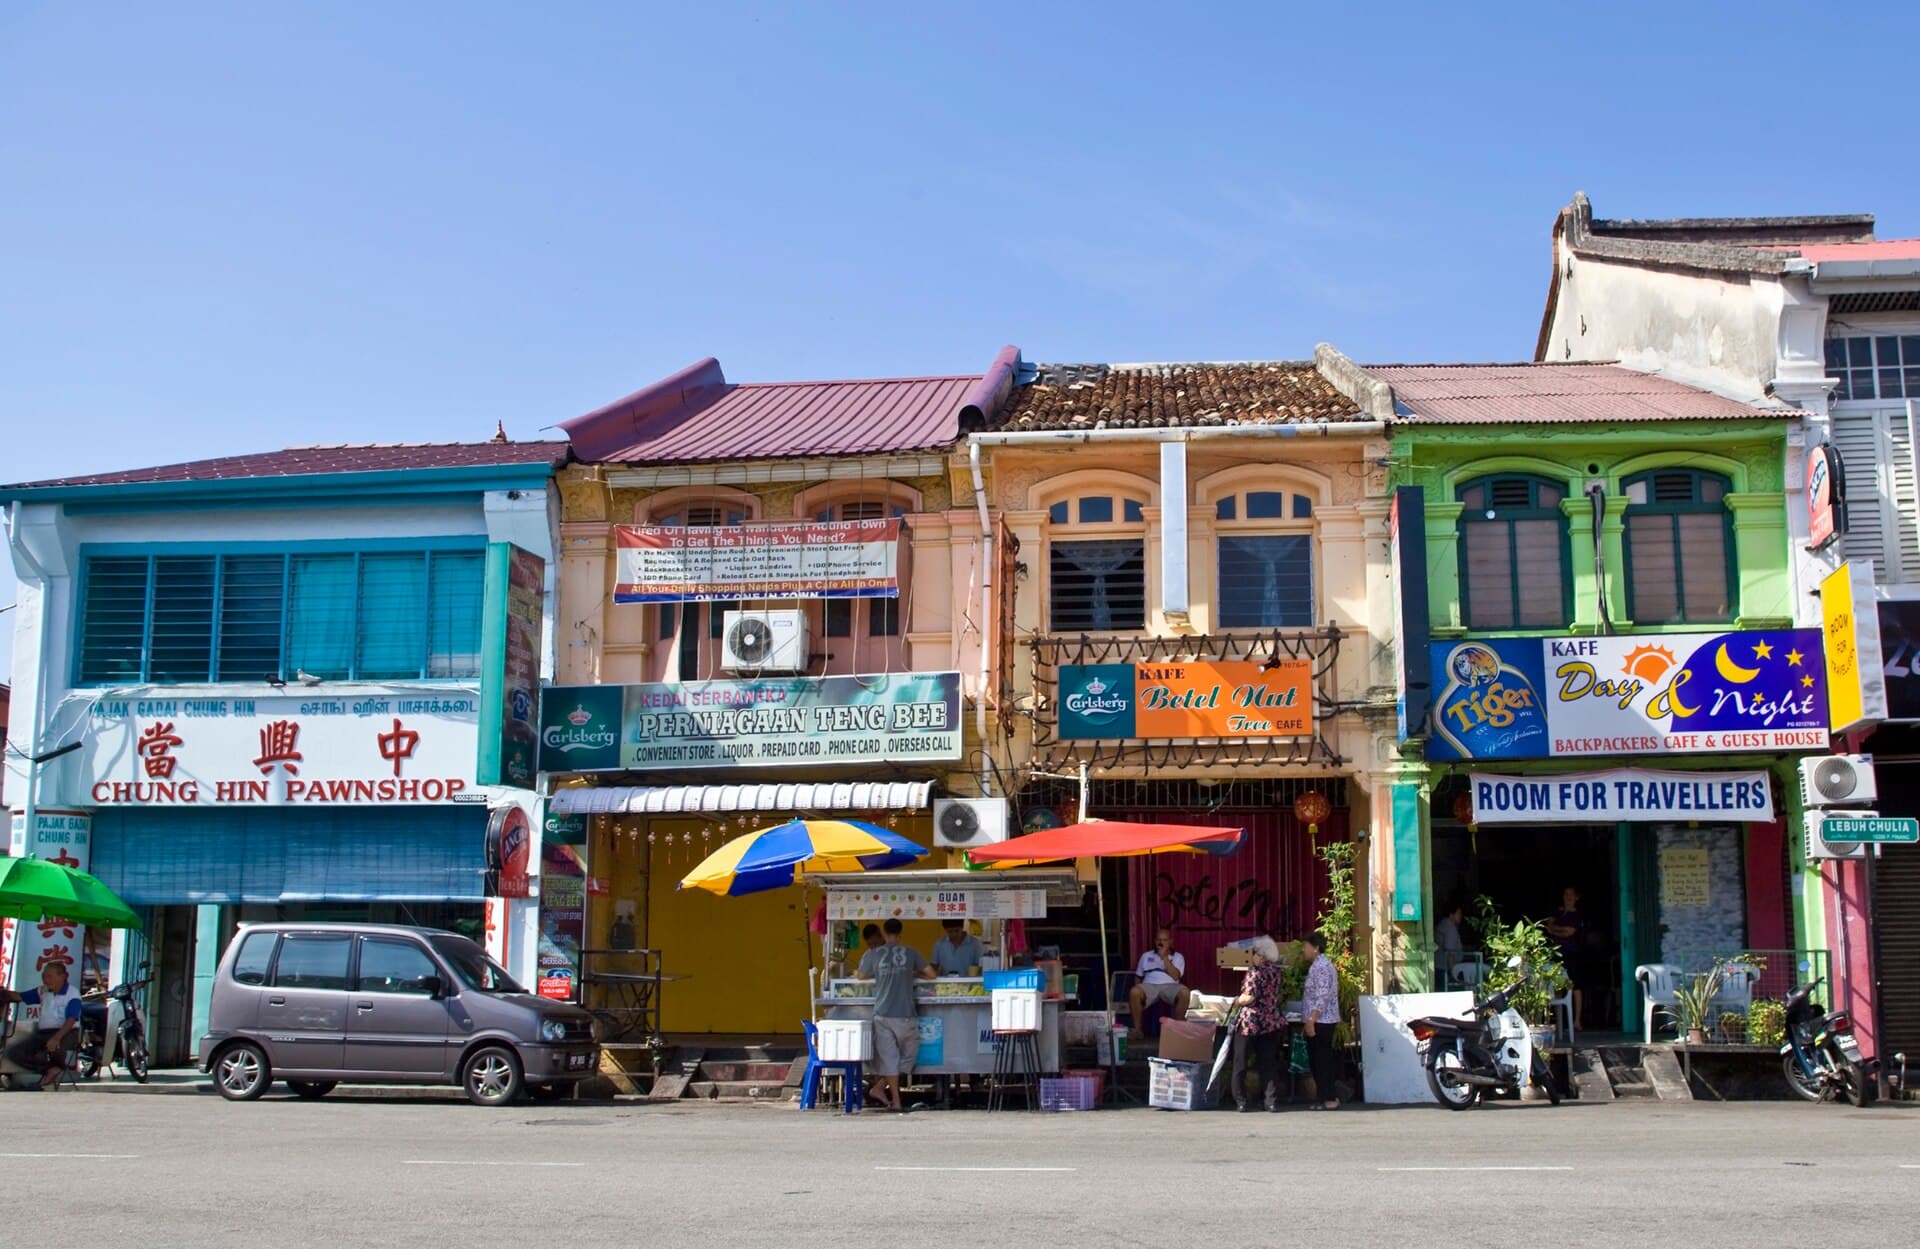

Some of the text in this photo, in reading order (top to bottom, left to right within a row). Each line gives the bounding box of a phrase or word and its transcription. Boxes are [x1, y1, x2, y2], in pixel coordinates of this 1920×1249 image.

[856, 519, 886, 530] Town
[671, 532, 846, 548] To Get The Things You Need?
[756, 546, 804, 554] Convenience
[631, 584, 645, 593] All
[646, 584, 669, 593] Your
[698, 584, 746, 594] Shopping
[752, 582, 779, 592] Needs
[840, 580, 854, 588] All
[868, 580, 888, 588] One
[1551, 641, 1598, 656] KAFE
[1138, 668, 1185, 680] KAFE
[640, 687, 788, 708] KEDAI SERBANEKA
[1066, 692, 1128, 714] Carlsberg
[1140, 684, 1298, 710] Betel Nut
[1556, 661, 1814, 726] Day & Night
[138, 700, 178, 717] GADAI
[184, 700, 228, 717] CHUNG
[234, 700, 256, 716] HIN
[1447, 682, 1534, 733] Tiger
[640, 701, 948, 738] PERNIAGAAN TENG BEE
[1226, 714, 1303, 732] Tree CAFE
[543, 724, 615, 748] Carlsberg
[1555, 736, 1658, 753] BACKPACKERS
[1664, 735, 1700, 750] CAFE
[1705, 734, 1716, 748] &
[1722, 733, 1768, 748] GUEST
[1774, 732, 1823, 746] HOUSE
[636, 736, 952, 762] CONVENIENT STORE LIQUOR PREPAID CARD PHONE CARD OVERSEAS CALL
[92, 778, 465, 803] CHUNG HIN PAWNSHOP
[1478, 780, 1766, 812] ROOM FOR TRAVELLERS
[38, 816, 65, 829] PAJAK
[1830, 821, 1910, 832] LEBUH CHULIA
[38, 830, 72, 844] CHUNG
[938, 892, 966, 902] GUAN
[878, 946, 908, 968] 28
